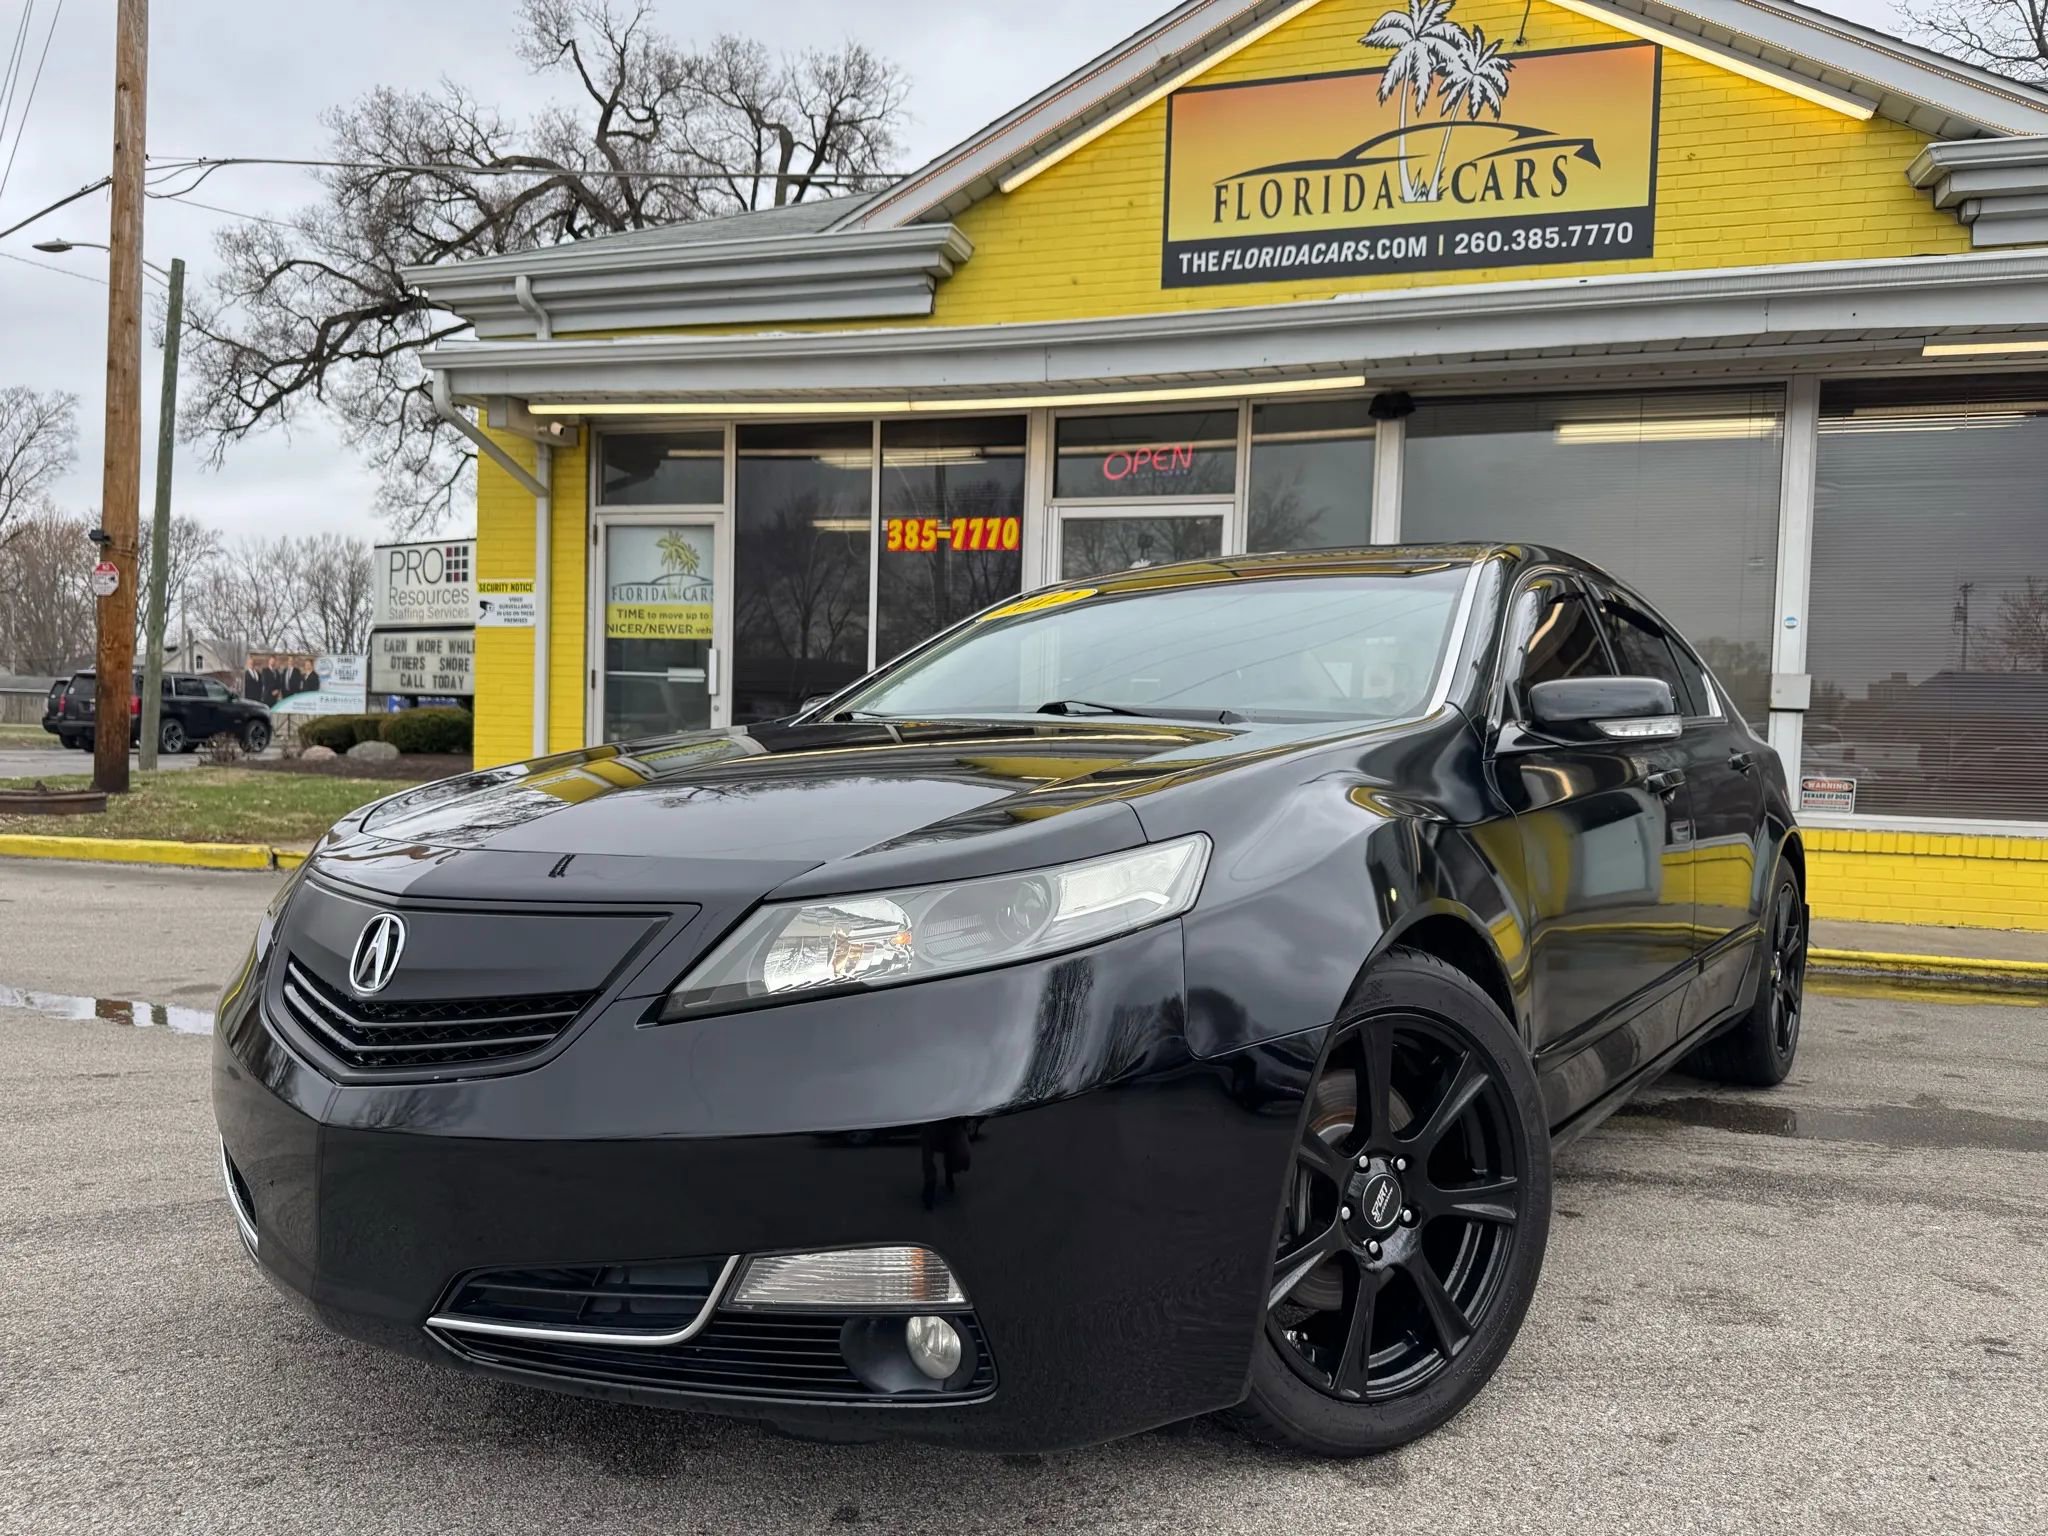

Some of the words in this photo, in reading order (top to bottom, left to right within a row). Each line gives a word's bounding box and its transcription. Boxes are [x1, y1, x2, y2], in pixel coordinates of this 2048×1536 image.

[1213, 170, 1395, 224] FLORIDA
[1451, 154, 1568, 204] CARS
[1179, 235, 1428, 274] THEFLORIDACARS.COM
[1454, 221, 1634, 255] 260.385.7770
[1103, 443, 1193, 480] OPEN
[887, 517, 1019, 552] 385-7770
[389, 547, 444, 587] PRO
[479, 583, 508, 593] SECURITY
[510, 582, 533, 593] NOTICE
[612, 586, 667, 601] FLORIDA
[389, 586, 470, 607] Resources
[389, 607, 425, 622] Staffing
[427, 606, 470, 619] Services
[616, 608, 645, 619] TIME
[647, 611, 657, 619] to
[659, 611, 684, 619] move
[686, 612, 698, 621] up
[700, 611, 710, 620] to
[607, 624, 693, 635] NICER/NEWER
[384, 638, 408, 653] EARN
[416, 640, 443, 654] MORE
[391, 656, 425, 671] OTHERS
[439, 657, 470, 673] SNORE
[400, 673, 425, 689] CALL
[432, 675, 464, 691] TODAY
[1808, 782, 1849, 790] WARNING
